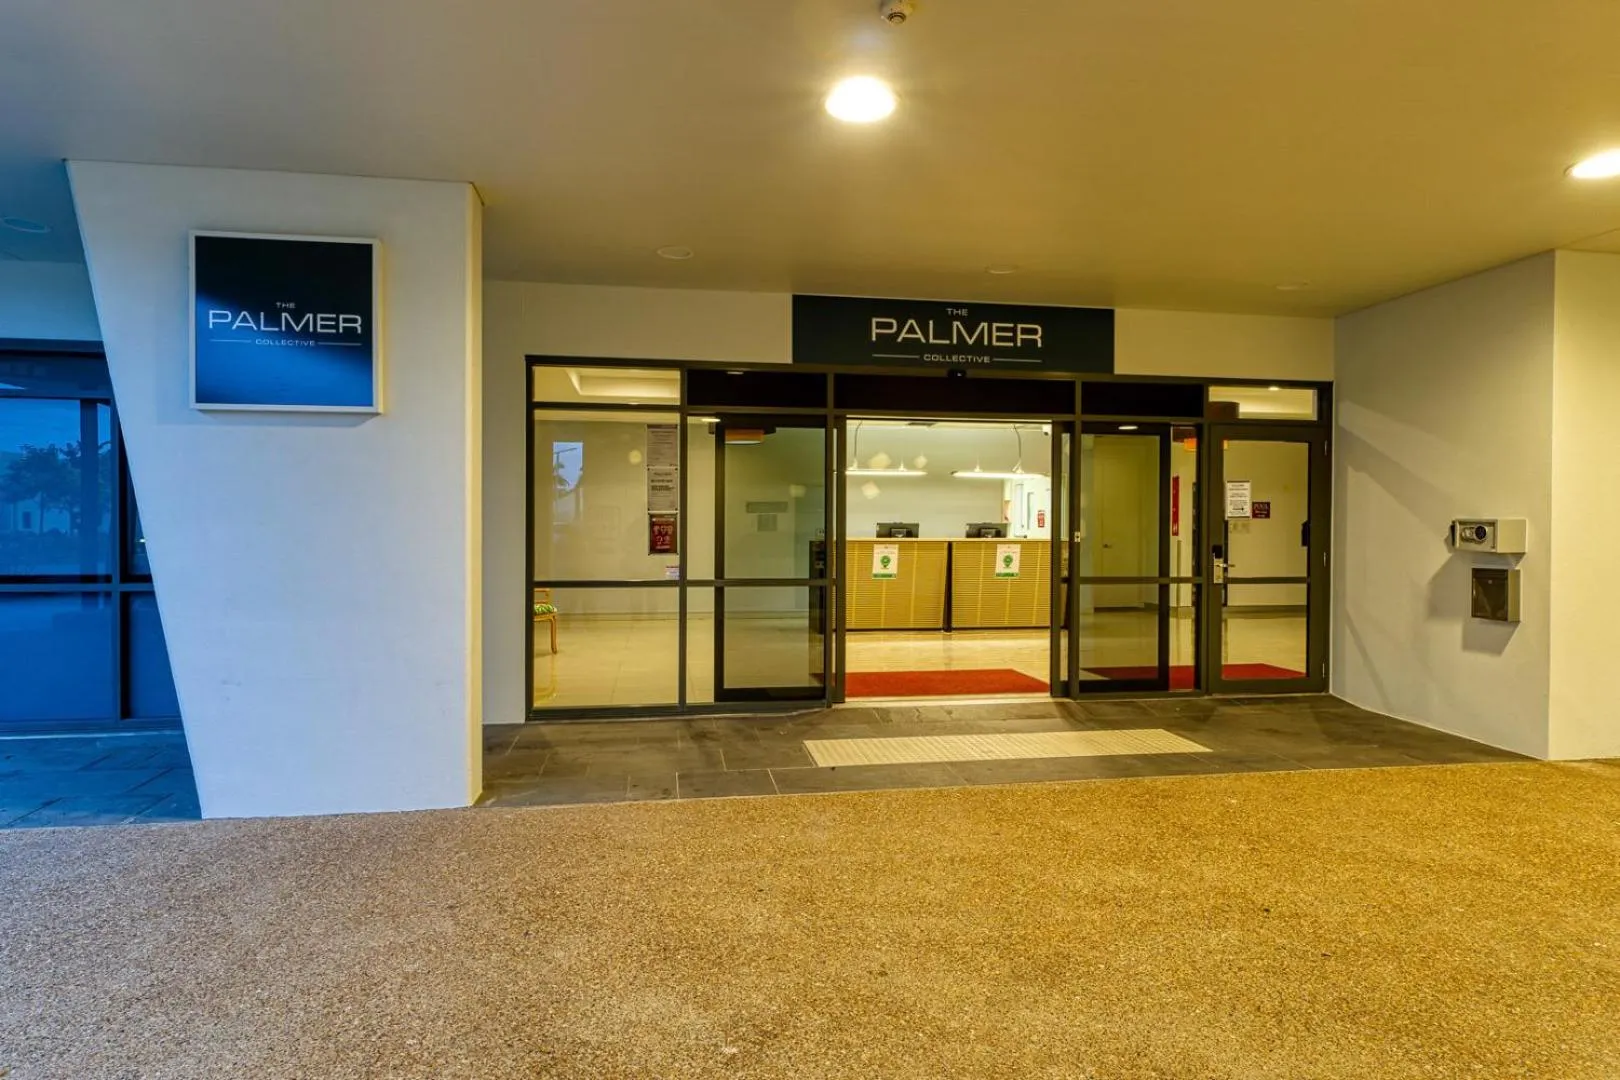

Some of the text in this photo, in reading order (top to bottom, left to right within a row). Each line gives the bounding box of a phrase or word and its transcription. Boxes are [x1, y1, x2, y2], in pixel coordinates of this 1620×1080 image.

[947, 308, 968, 316] THE
[209, 311, 362, 333] PALMER
[872, 318, 1042, 347] PALMER
[924, 354, 990, 363] COLLECTIVE
